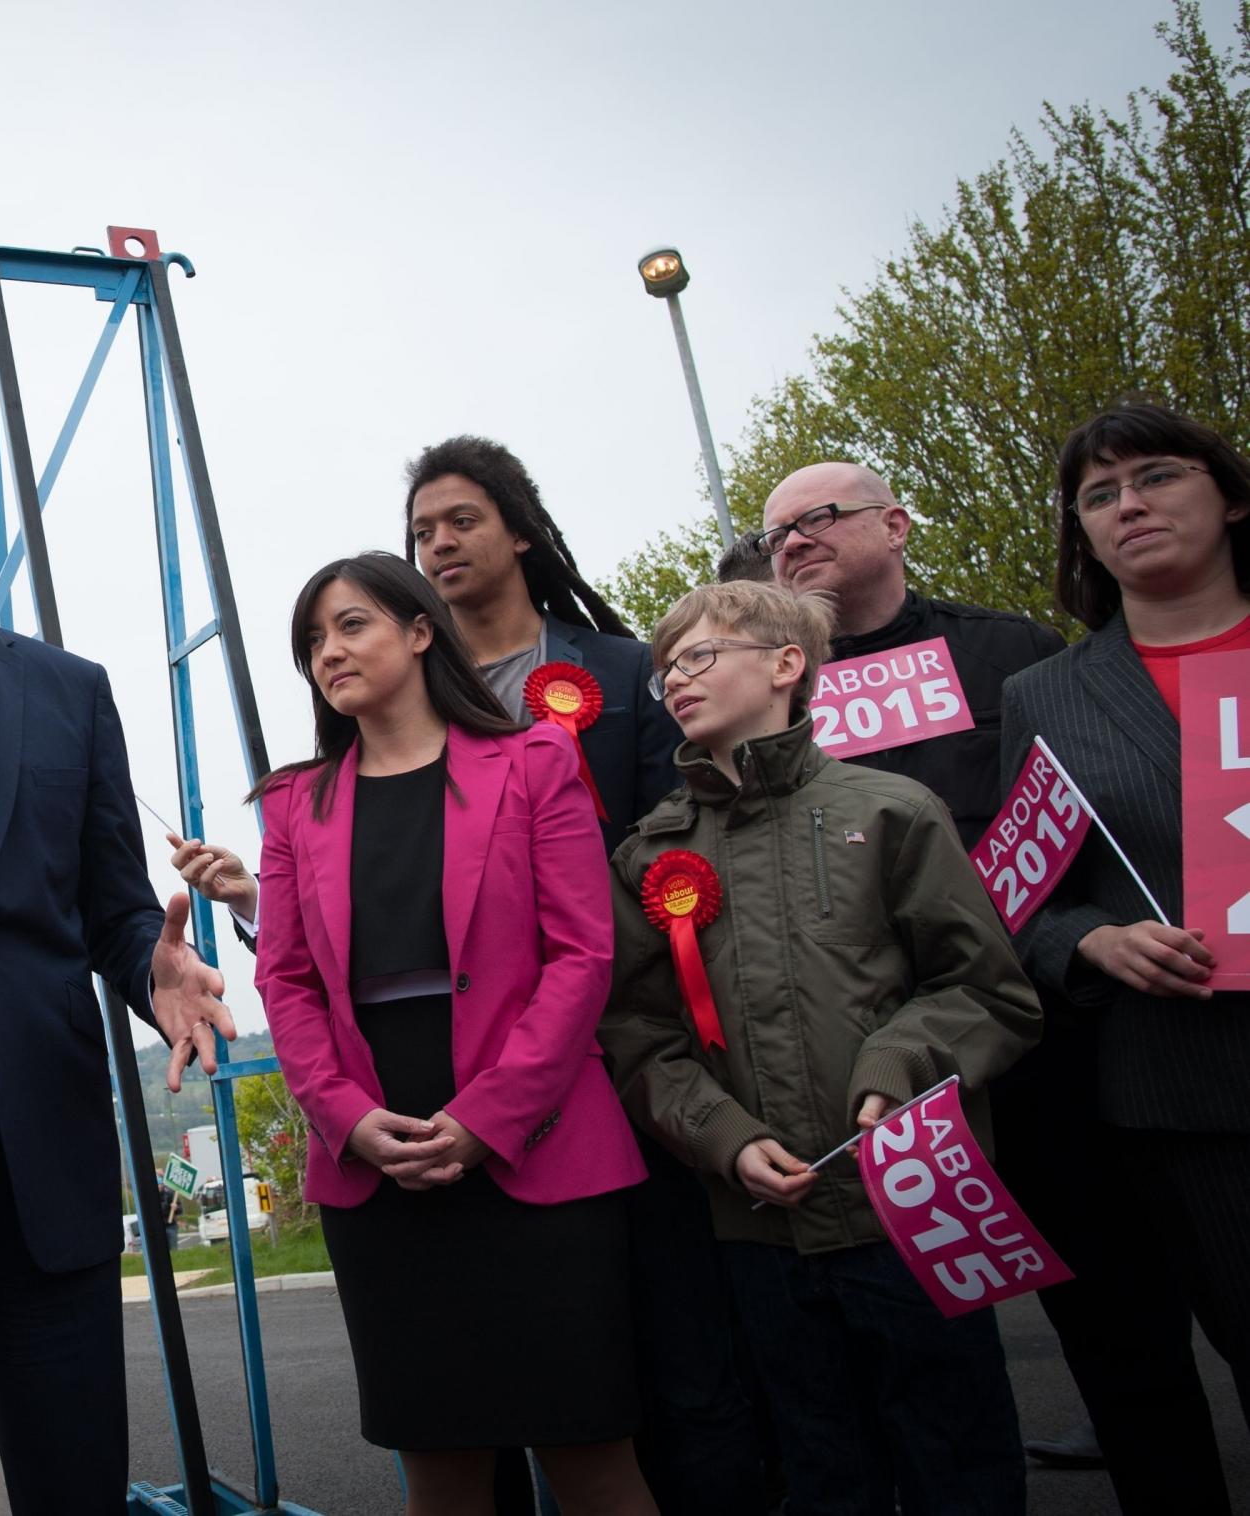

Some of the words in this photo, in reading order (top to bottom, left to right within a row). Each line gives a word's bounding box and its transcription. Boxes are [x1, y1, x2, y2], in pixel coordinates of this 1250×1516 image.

[549, 690, 578, 702] Labour
[811, 677, 960, 748] 2015
[812, 650, 945, 701] ABOUR
[975, 755, 1054, 879] LABOUR
[992, 777, 1081, 918] 2015
[664, 886, 694, 902] Labour
[872, 1110, 1008, 1301] 2015
[919, 1088, 1045, 1281] LABOUR
